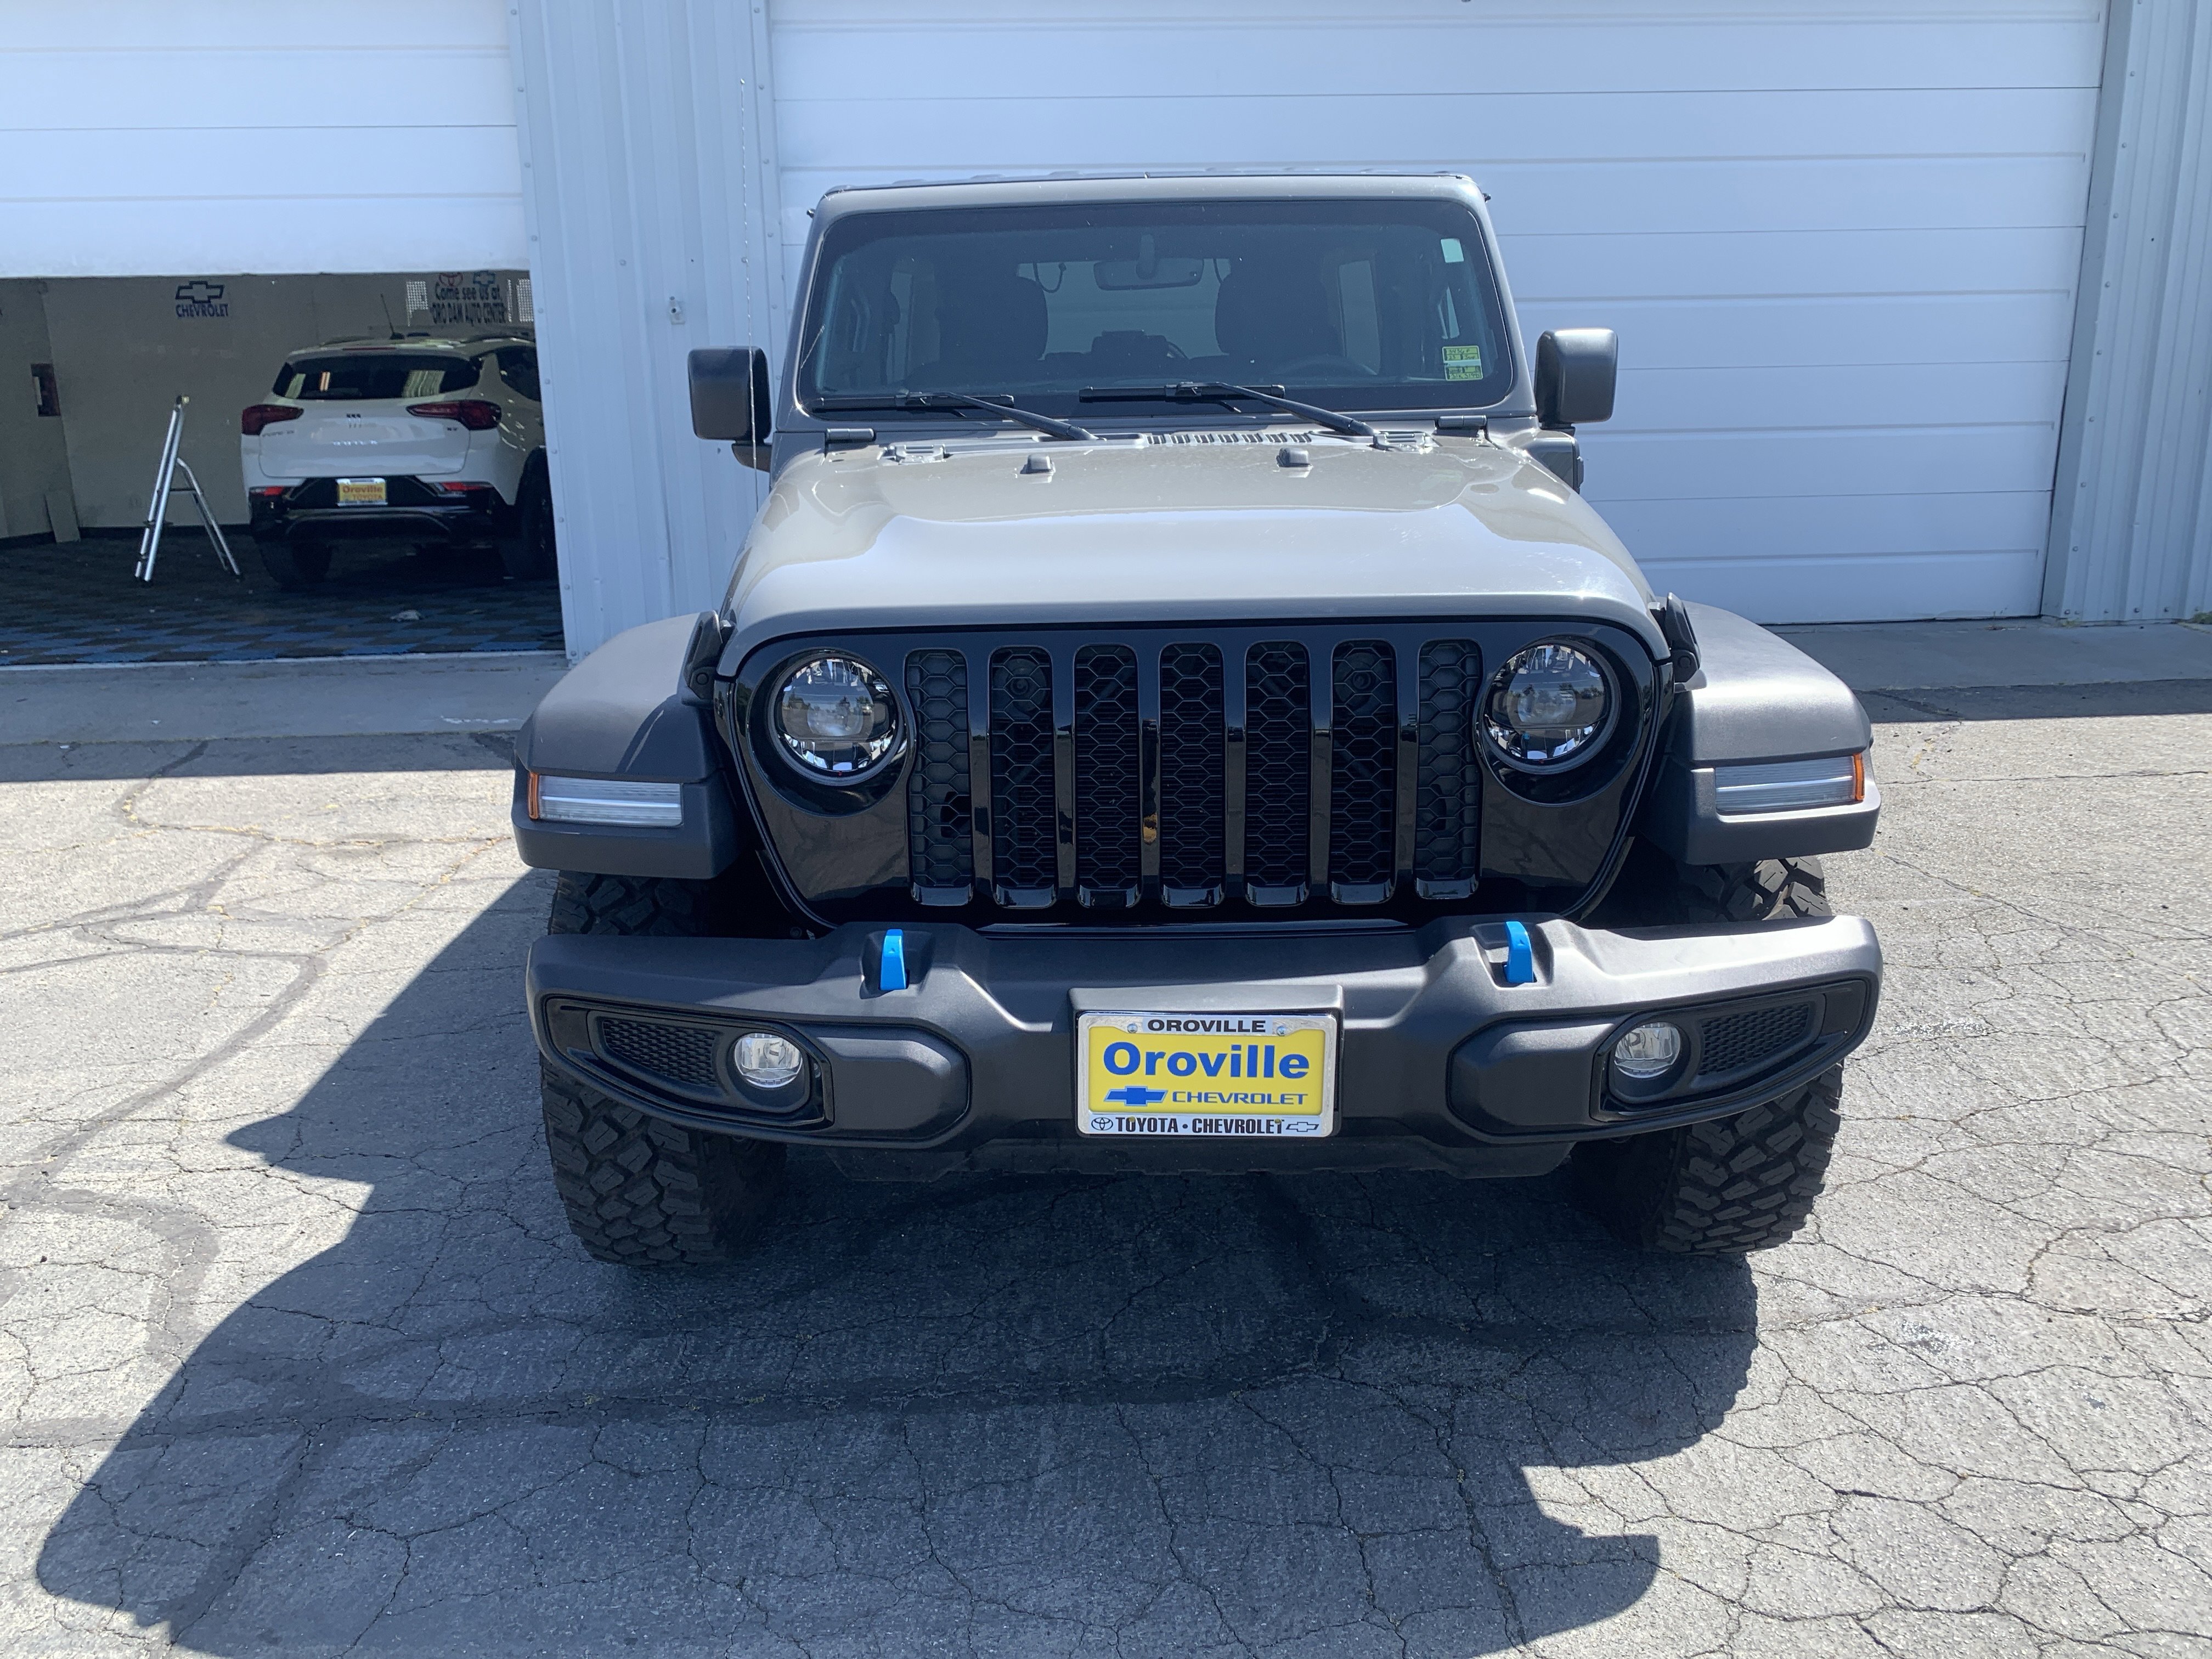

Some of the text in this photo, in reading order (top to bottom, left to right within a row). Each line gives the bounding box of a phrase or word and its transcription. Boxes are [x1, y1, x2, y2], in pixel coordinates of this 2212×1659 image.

[176, 303, 228, 317] CHEVROLET
[342, 484, 383, 493] Oroville
[1148, 1019, 1266, 1033] OROVILLE
[1103, 1041, 1310, 1079] Oroville
[1172, 1091, 1308, 1105] CHEVROLET
[1115, 1117, 1285, 1134] TOYOTA CHEVROLET
